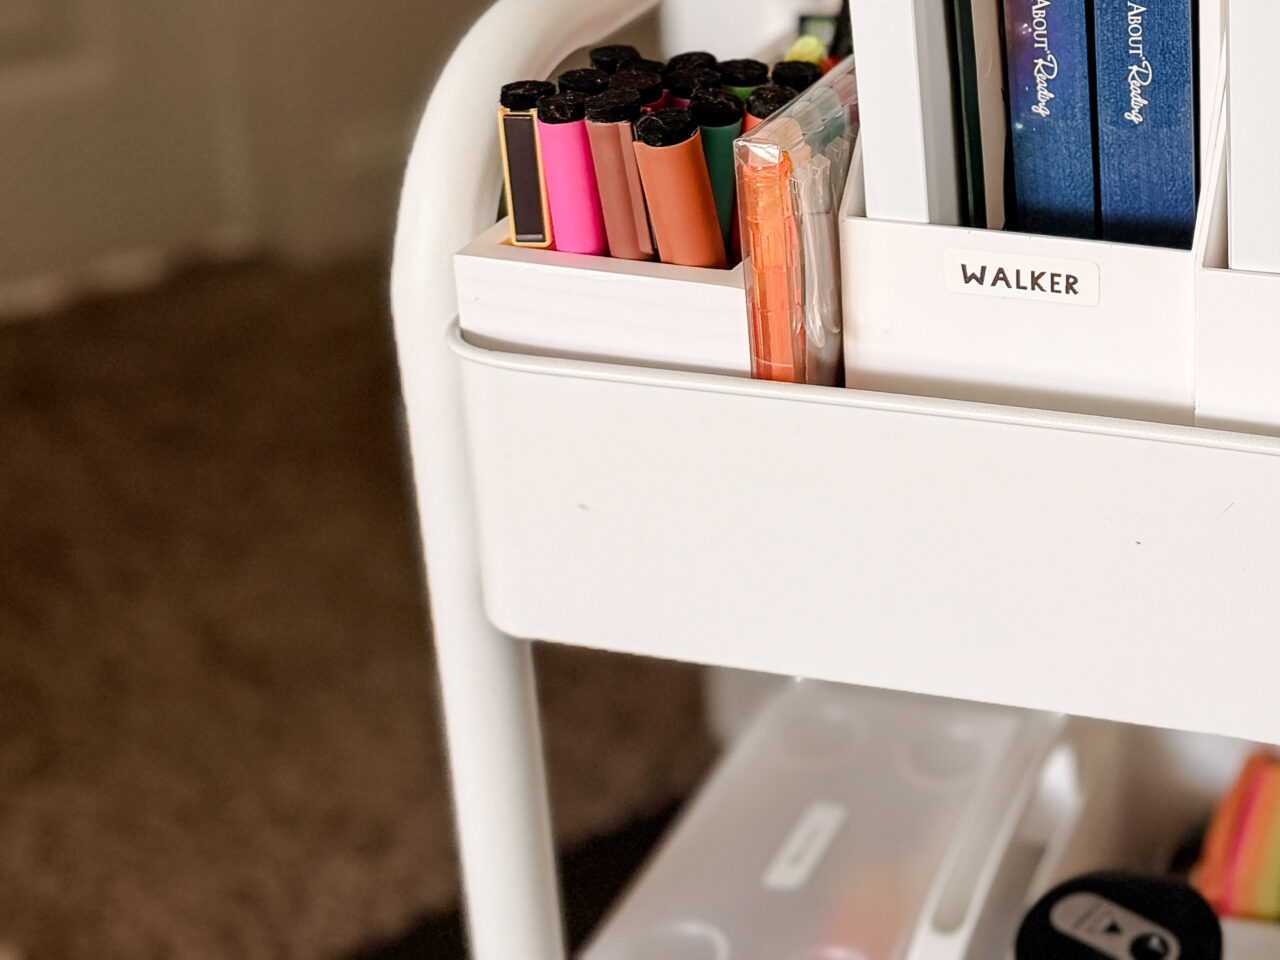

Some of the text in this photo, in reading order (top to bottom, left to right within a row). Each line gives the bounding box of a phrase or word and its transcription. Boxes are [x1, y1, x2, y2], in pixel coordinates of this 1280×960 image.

[1031, 53, 1058, 118] Reading
[1124, 60, 1152, 125] Reading
[960, 263, 1080, 296] WALKER
